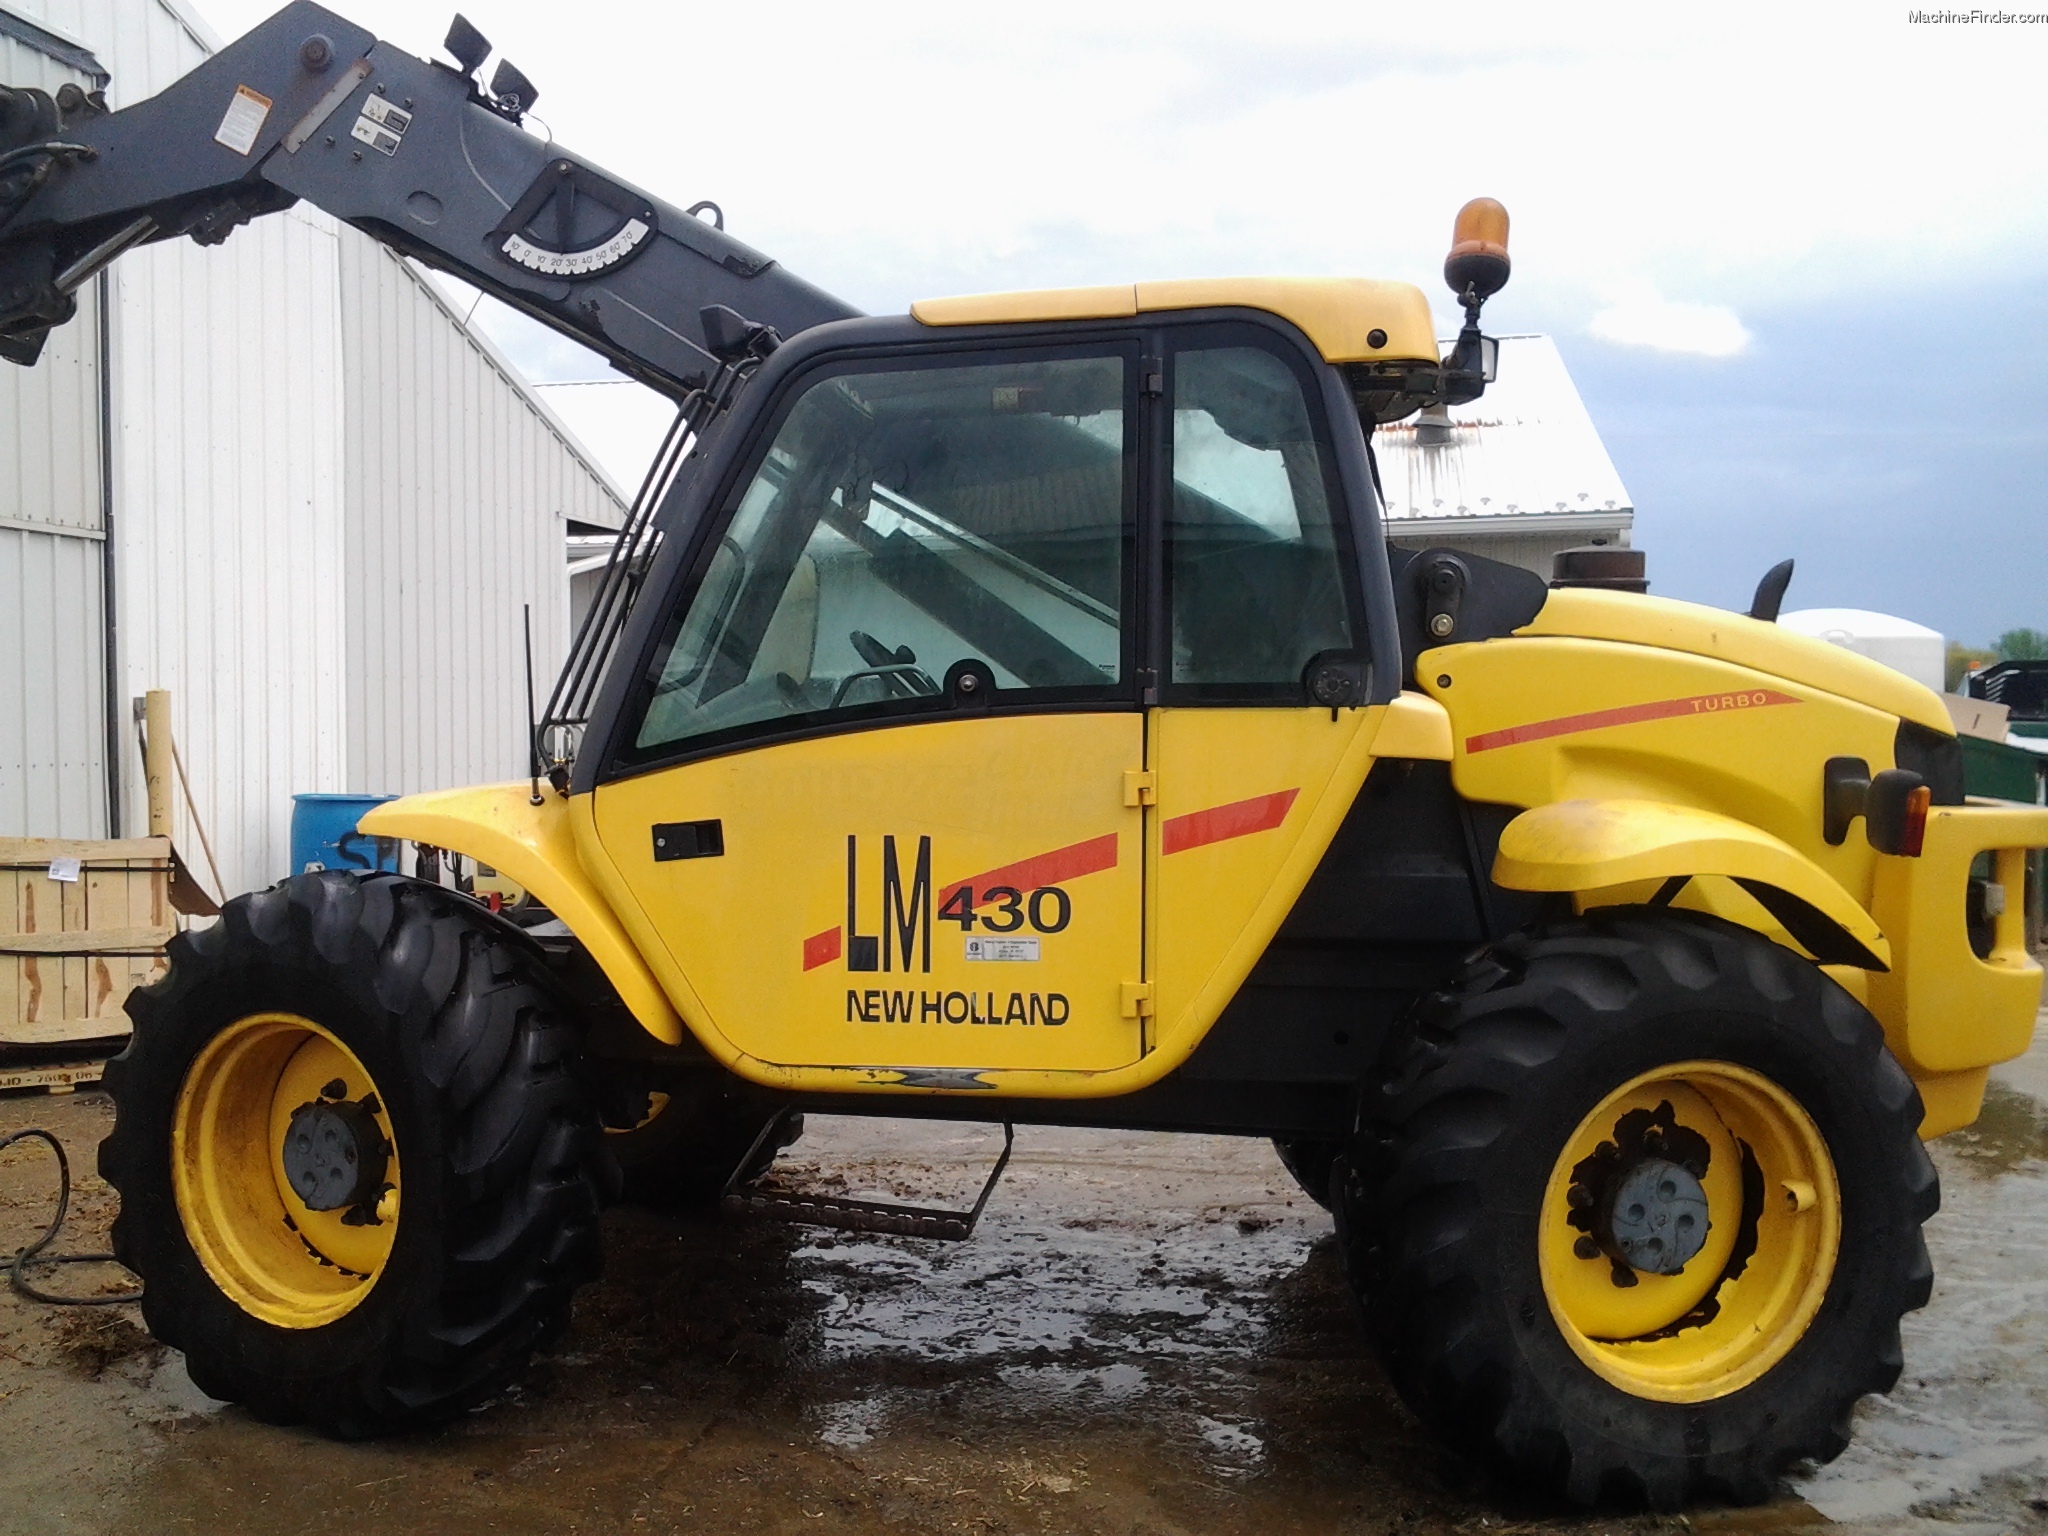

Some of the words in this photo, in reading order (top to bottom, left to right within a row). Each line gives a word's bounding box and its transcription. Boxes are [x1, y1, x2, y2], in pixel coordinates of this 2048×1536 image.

[1690, 692, 1766, 712] TURBO
[847, 834, 931, 973] LM
[937, 885, 1071, 934] 430
[846, 989, 914, 1023] NEW
[920, 990, 1070, 1026] HOLLAND
